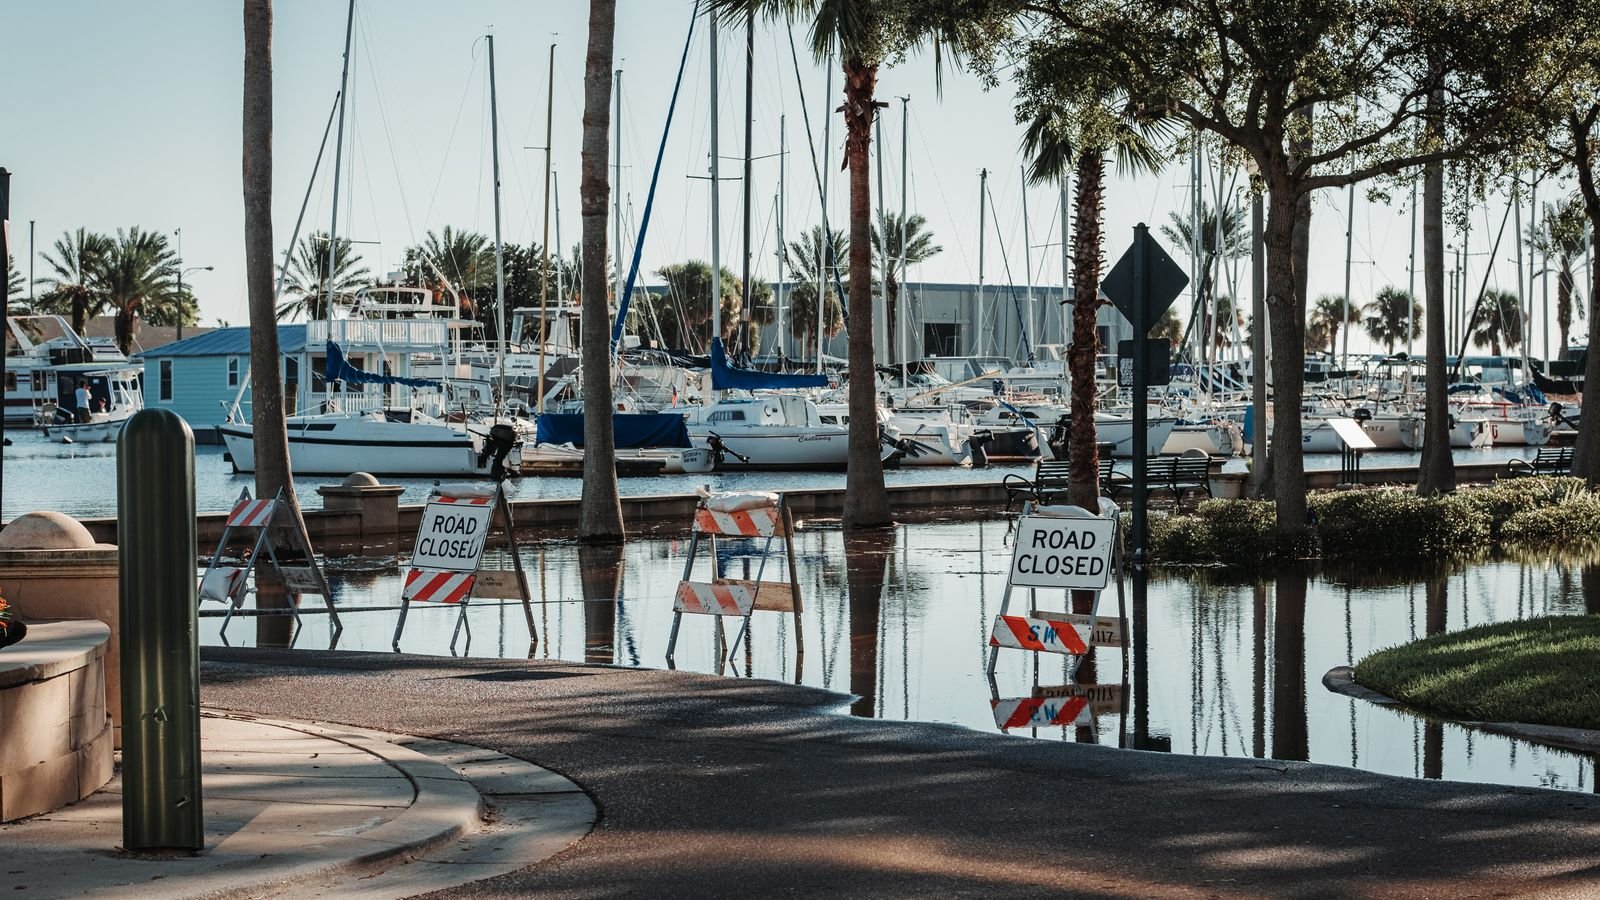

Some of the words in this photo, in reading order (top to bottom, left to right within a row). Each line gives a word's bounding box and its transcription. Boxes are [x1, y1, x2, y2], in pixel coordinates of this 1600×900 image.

[798, 434, 832, 443] Castaway
[432, 515, 477, 535] ROAD
[419, 537, 479, 559] CLOSED
[1032, 529, 1096, 550] ROAD
[1017, 554, 1104, 576] CLOSED
